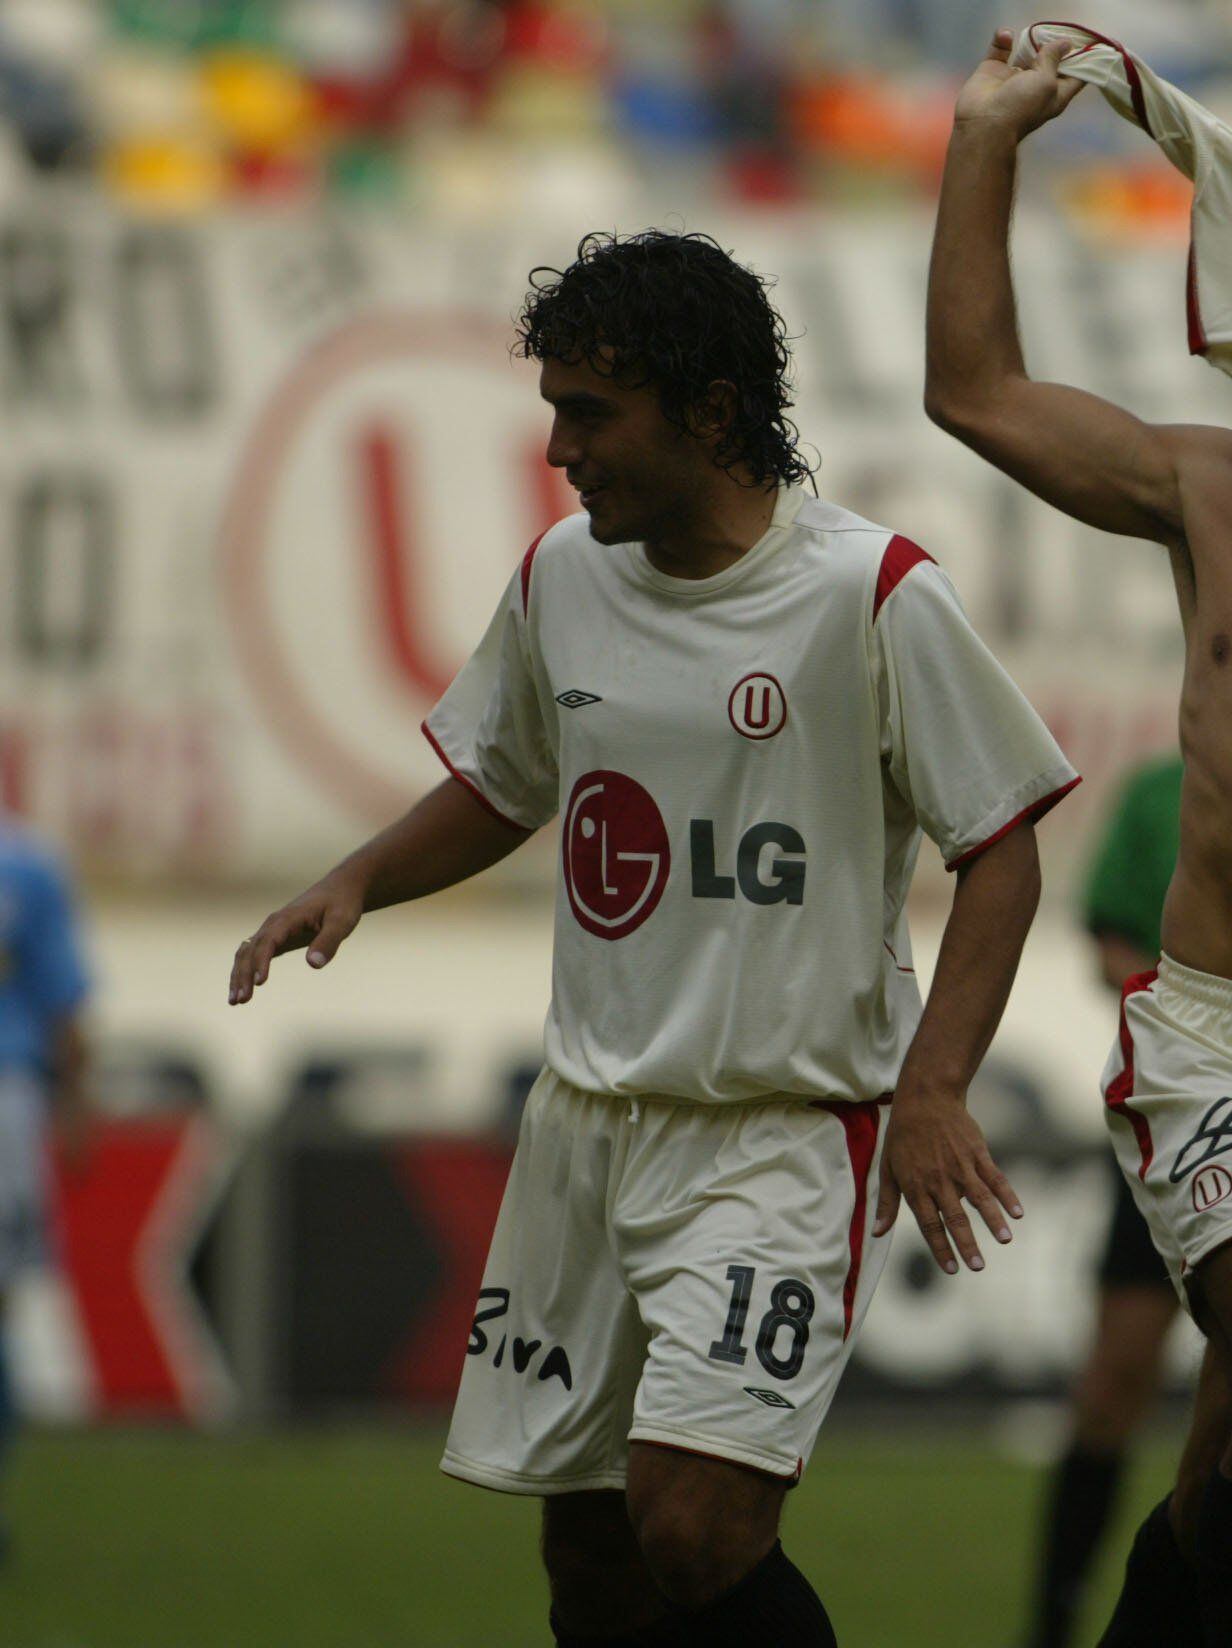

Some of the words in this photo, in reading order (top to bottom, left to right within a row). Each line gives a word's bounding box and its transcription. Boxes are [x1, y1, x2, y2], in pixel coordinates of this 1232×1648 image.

[744, 685, 770, 729] U
[690, 818, 806, 906] LG
[708, 1264, 815, 1381] 18
